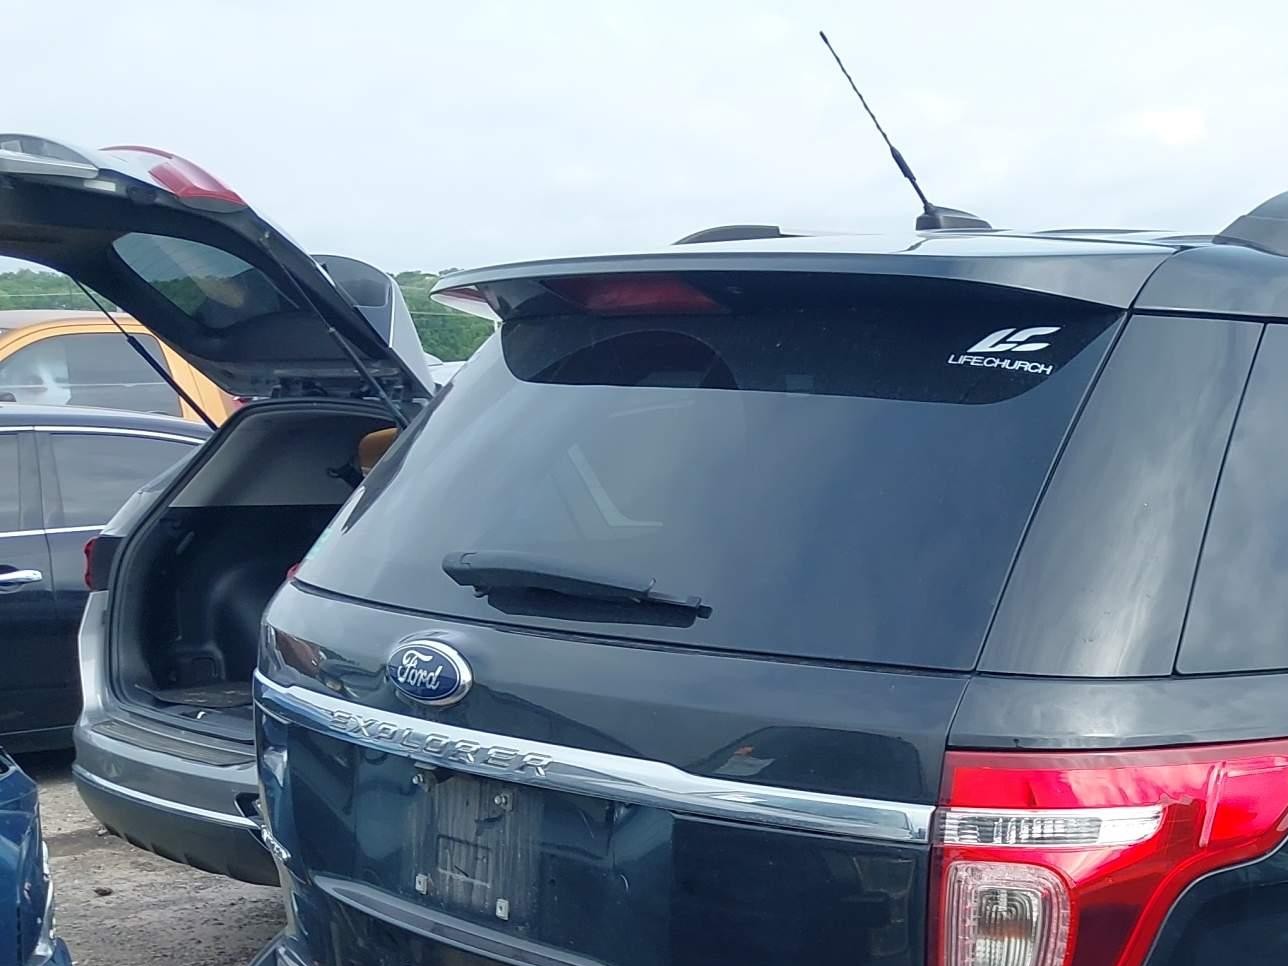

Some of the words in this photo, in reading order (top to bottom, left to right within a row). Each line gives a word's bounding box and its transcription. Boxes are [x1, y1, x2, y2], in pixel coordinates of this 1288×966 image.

[947, 354, 1053, 375] LIFECHURCH
[397, 650, 443, 690] Ford
[330, 710, 553, 776] EXPLORER
